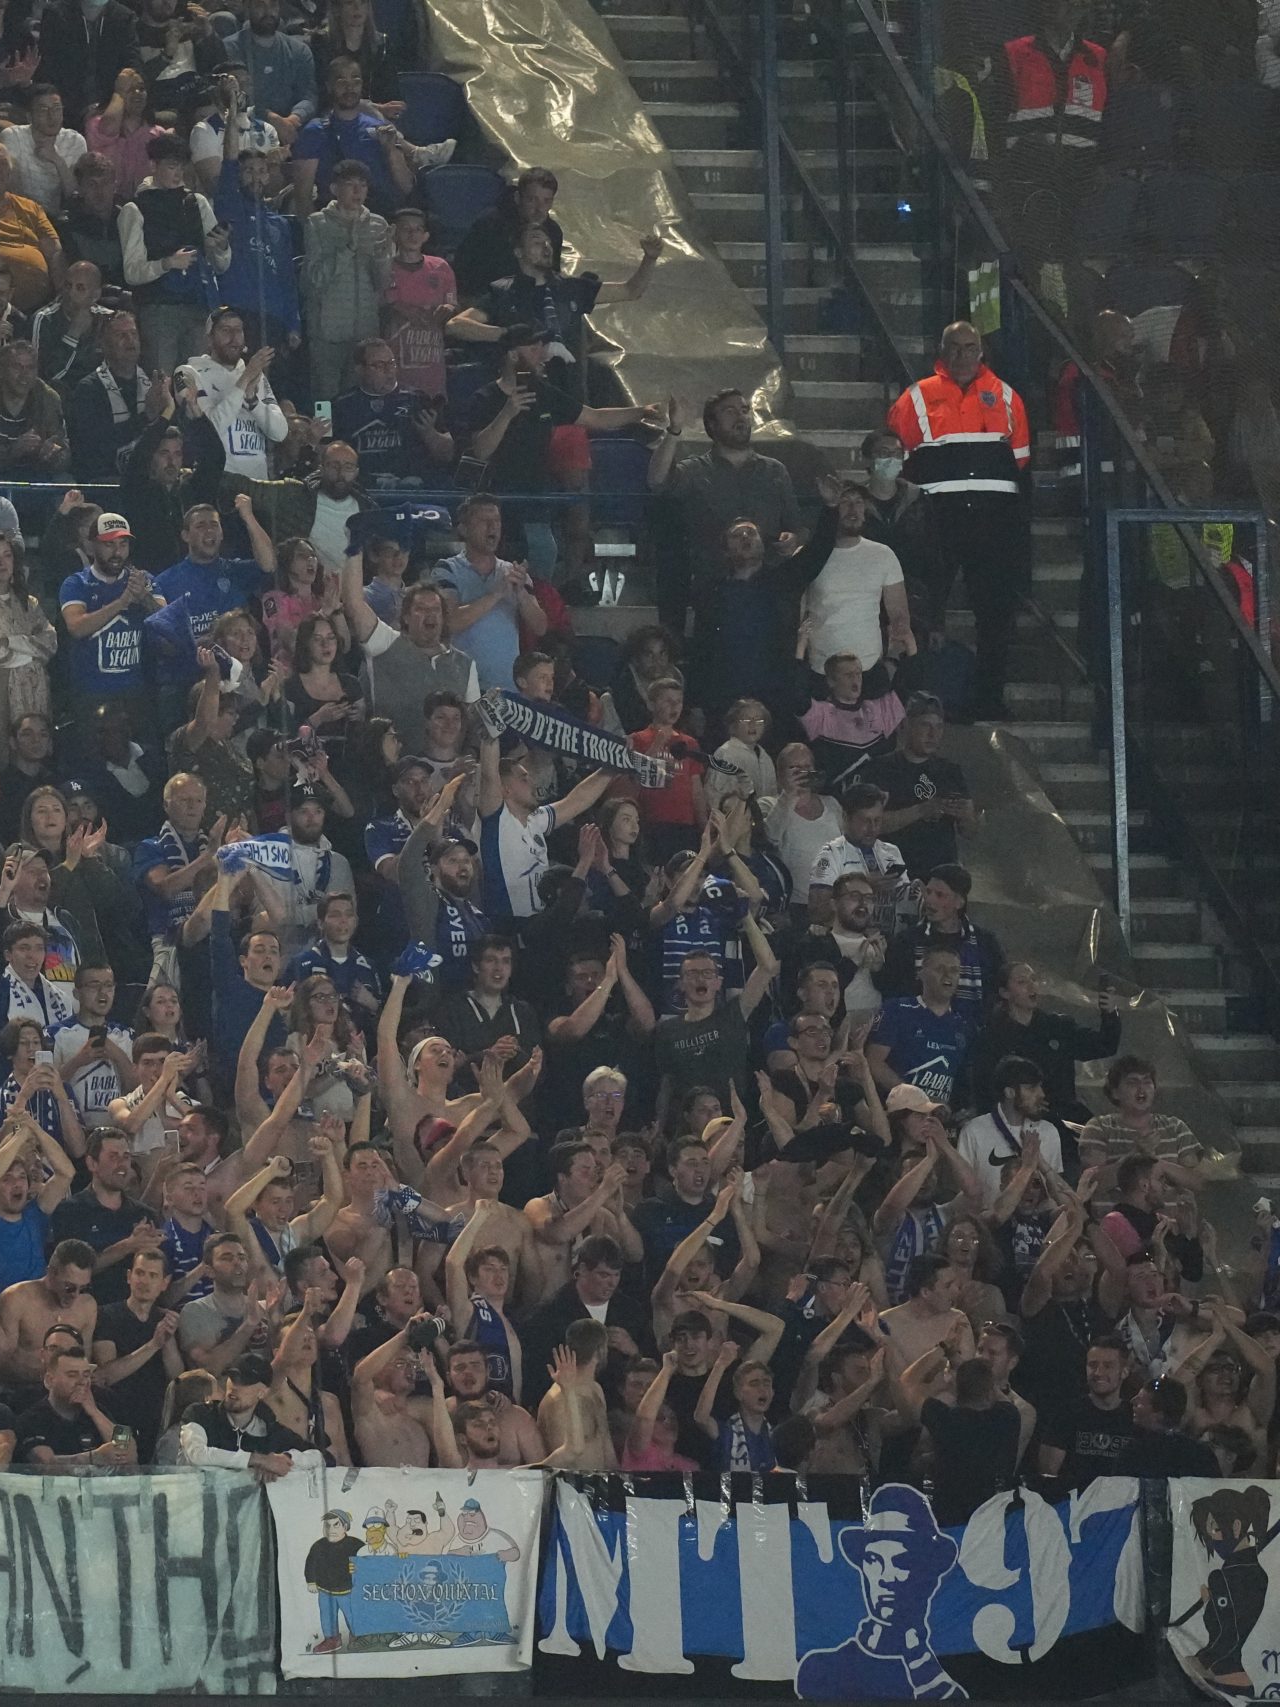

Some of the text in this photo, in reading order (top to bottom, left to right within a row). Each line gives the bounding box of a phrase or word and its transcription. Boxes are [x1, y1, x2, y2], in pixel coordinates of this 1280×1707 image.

[235, 418, 257, 434] BABE
[531, 709, 582, 757] D'ETRE
[674, 1029, 720, 1050] HOLLISTER
[91, 1076, 117, 1092] BABE
[919, 1070, 954, 1093] BABEA
[362, 1583, 430, 1602] SECTION
